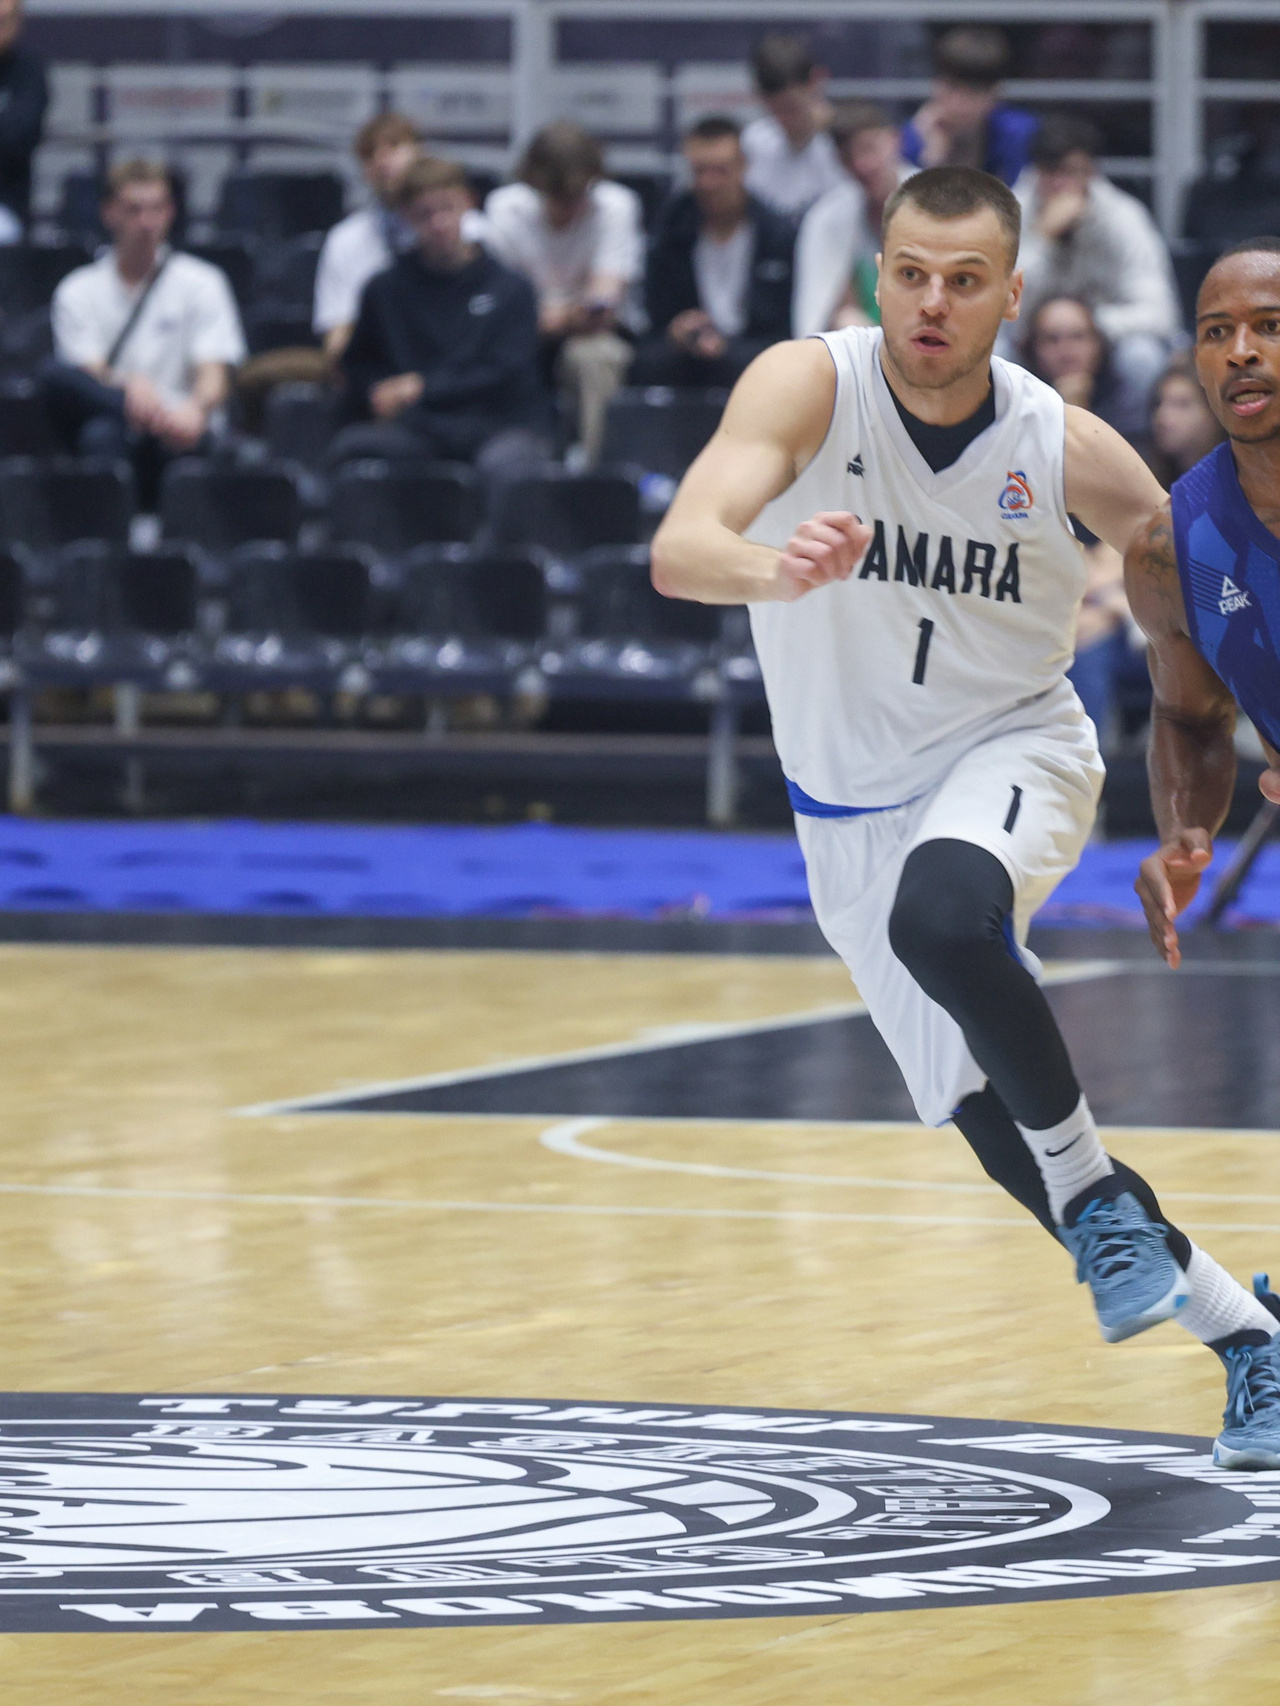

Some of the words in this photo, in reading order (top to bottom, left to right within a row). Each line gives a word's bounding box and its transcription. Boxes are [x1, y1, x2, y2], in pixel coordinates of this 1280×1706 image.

[855, 514, 1022, 603] AMARA
[1218, 590, 1252, 616] PEAK
[912, 617, 934, 685] 1
[1002, 783, 1023, 835] 1
[138, 1399, 934, 1434] ТУРНИР
[130, 1423, 1051, 1540] BASKETBALL
[165, 1545, 826, 1587] CLUB
